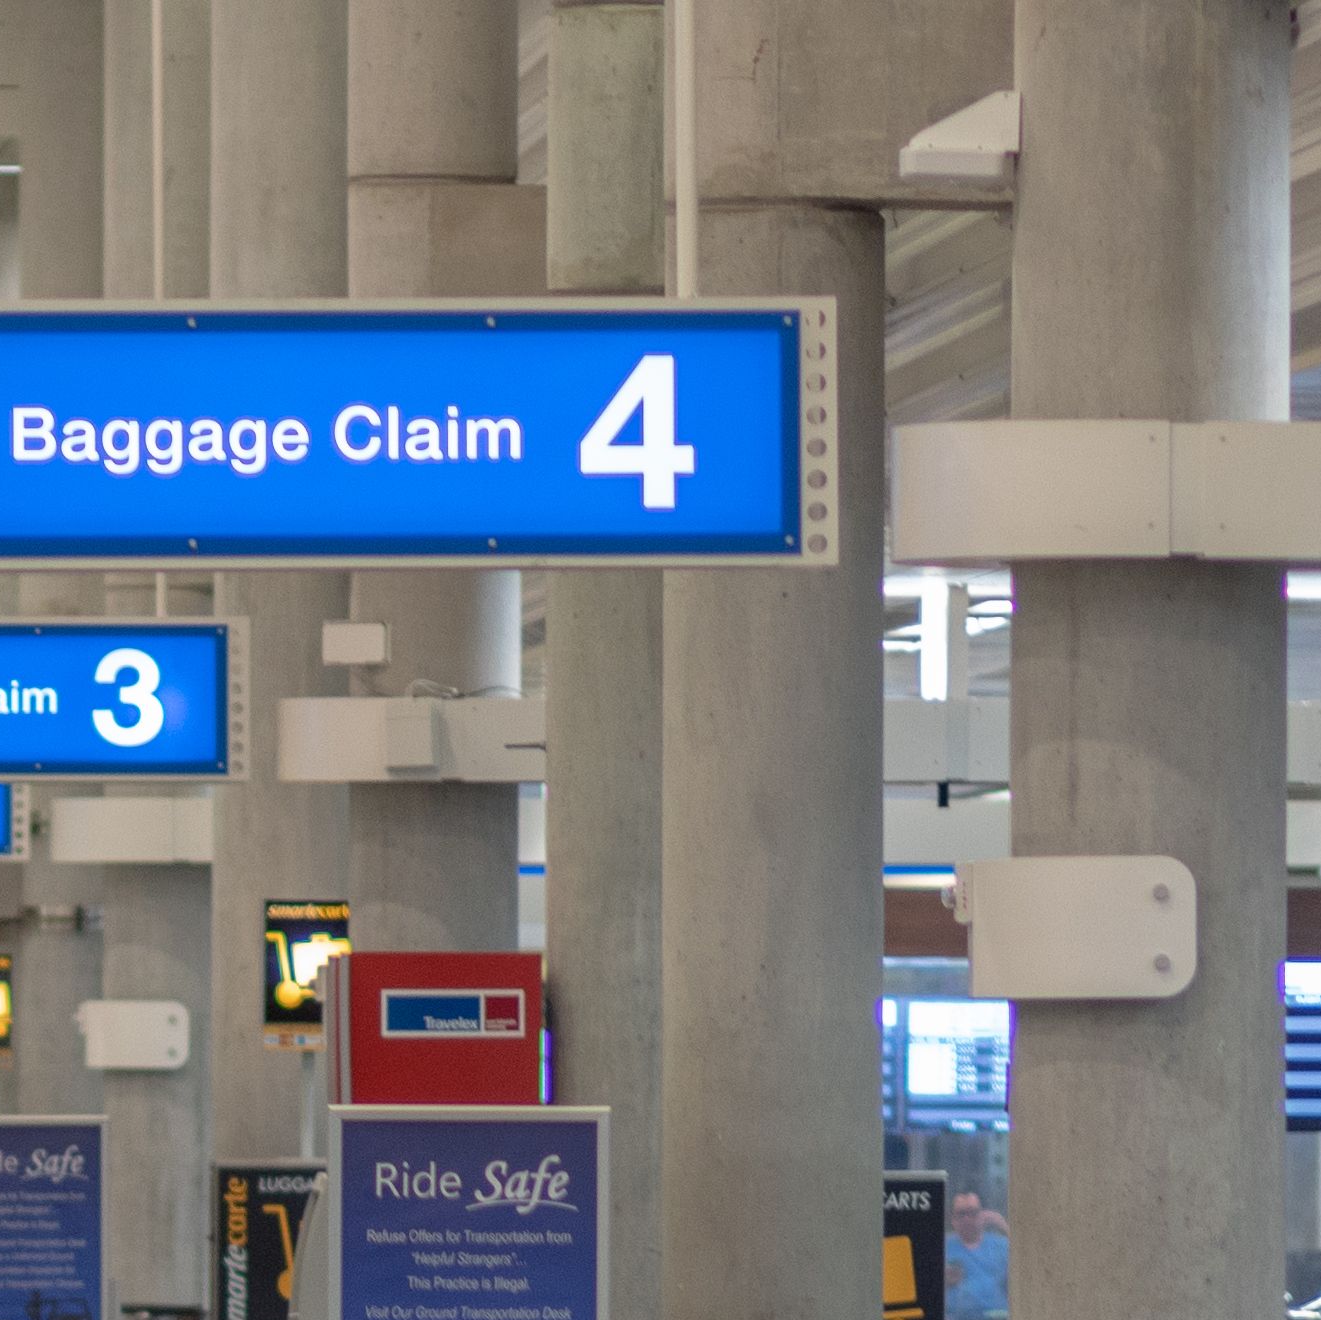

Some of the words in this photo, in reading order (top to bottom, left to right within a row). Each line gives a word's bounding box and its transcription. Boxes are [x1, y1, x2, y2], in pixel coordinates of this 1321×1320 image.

[11, 405, 311, 475] Baggage
[333, 403, 522, 461] Claim
[579, 353, 696, 510] 4
[91, 648, 165, 748] 3
[423, 1015, 478, 1030] Travelex
[23, 1144, 86, 1183] Safe
[374, 1160, 462, 1200] Ride
[469, 1154, 574, 1214] Safe
[883, 1190, 931, 1211] ARTS
[366, 1228, 407, 1244] Refuse
[409, 1228, 443, 1244] Offers
[445, 1229, 461, 1244] for
[464, 1229, 545, 1245] Transportation
[546, 1230, 573, 1244] from
[407, 1275, 432, 1290] This
[433, 1275, 479, 1290] Practice
[481, 1276, 492, 1290] is
[365, 1304, 389, 1320] Visit
[391, 1305, 413, 1320] Our
[415, 1305, 458, 1320] Ground
[542, 1306, 573, 1320] Desk
